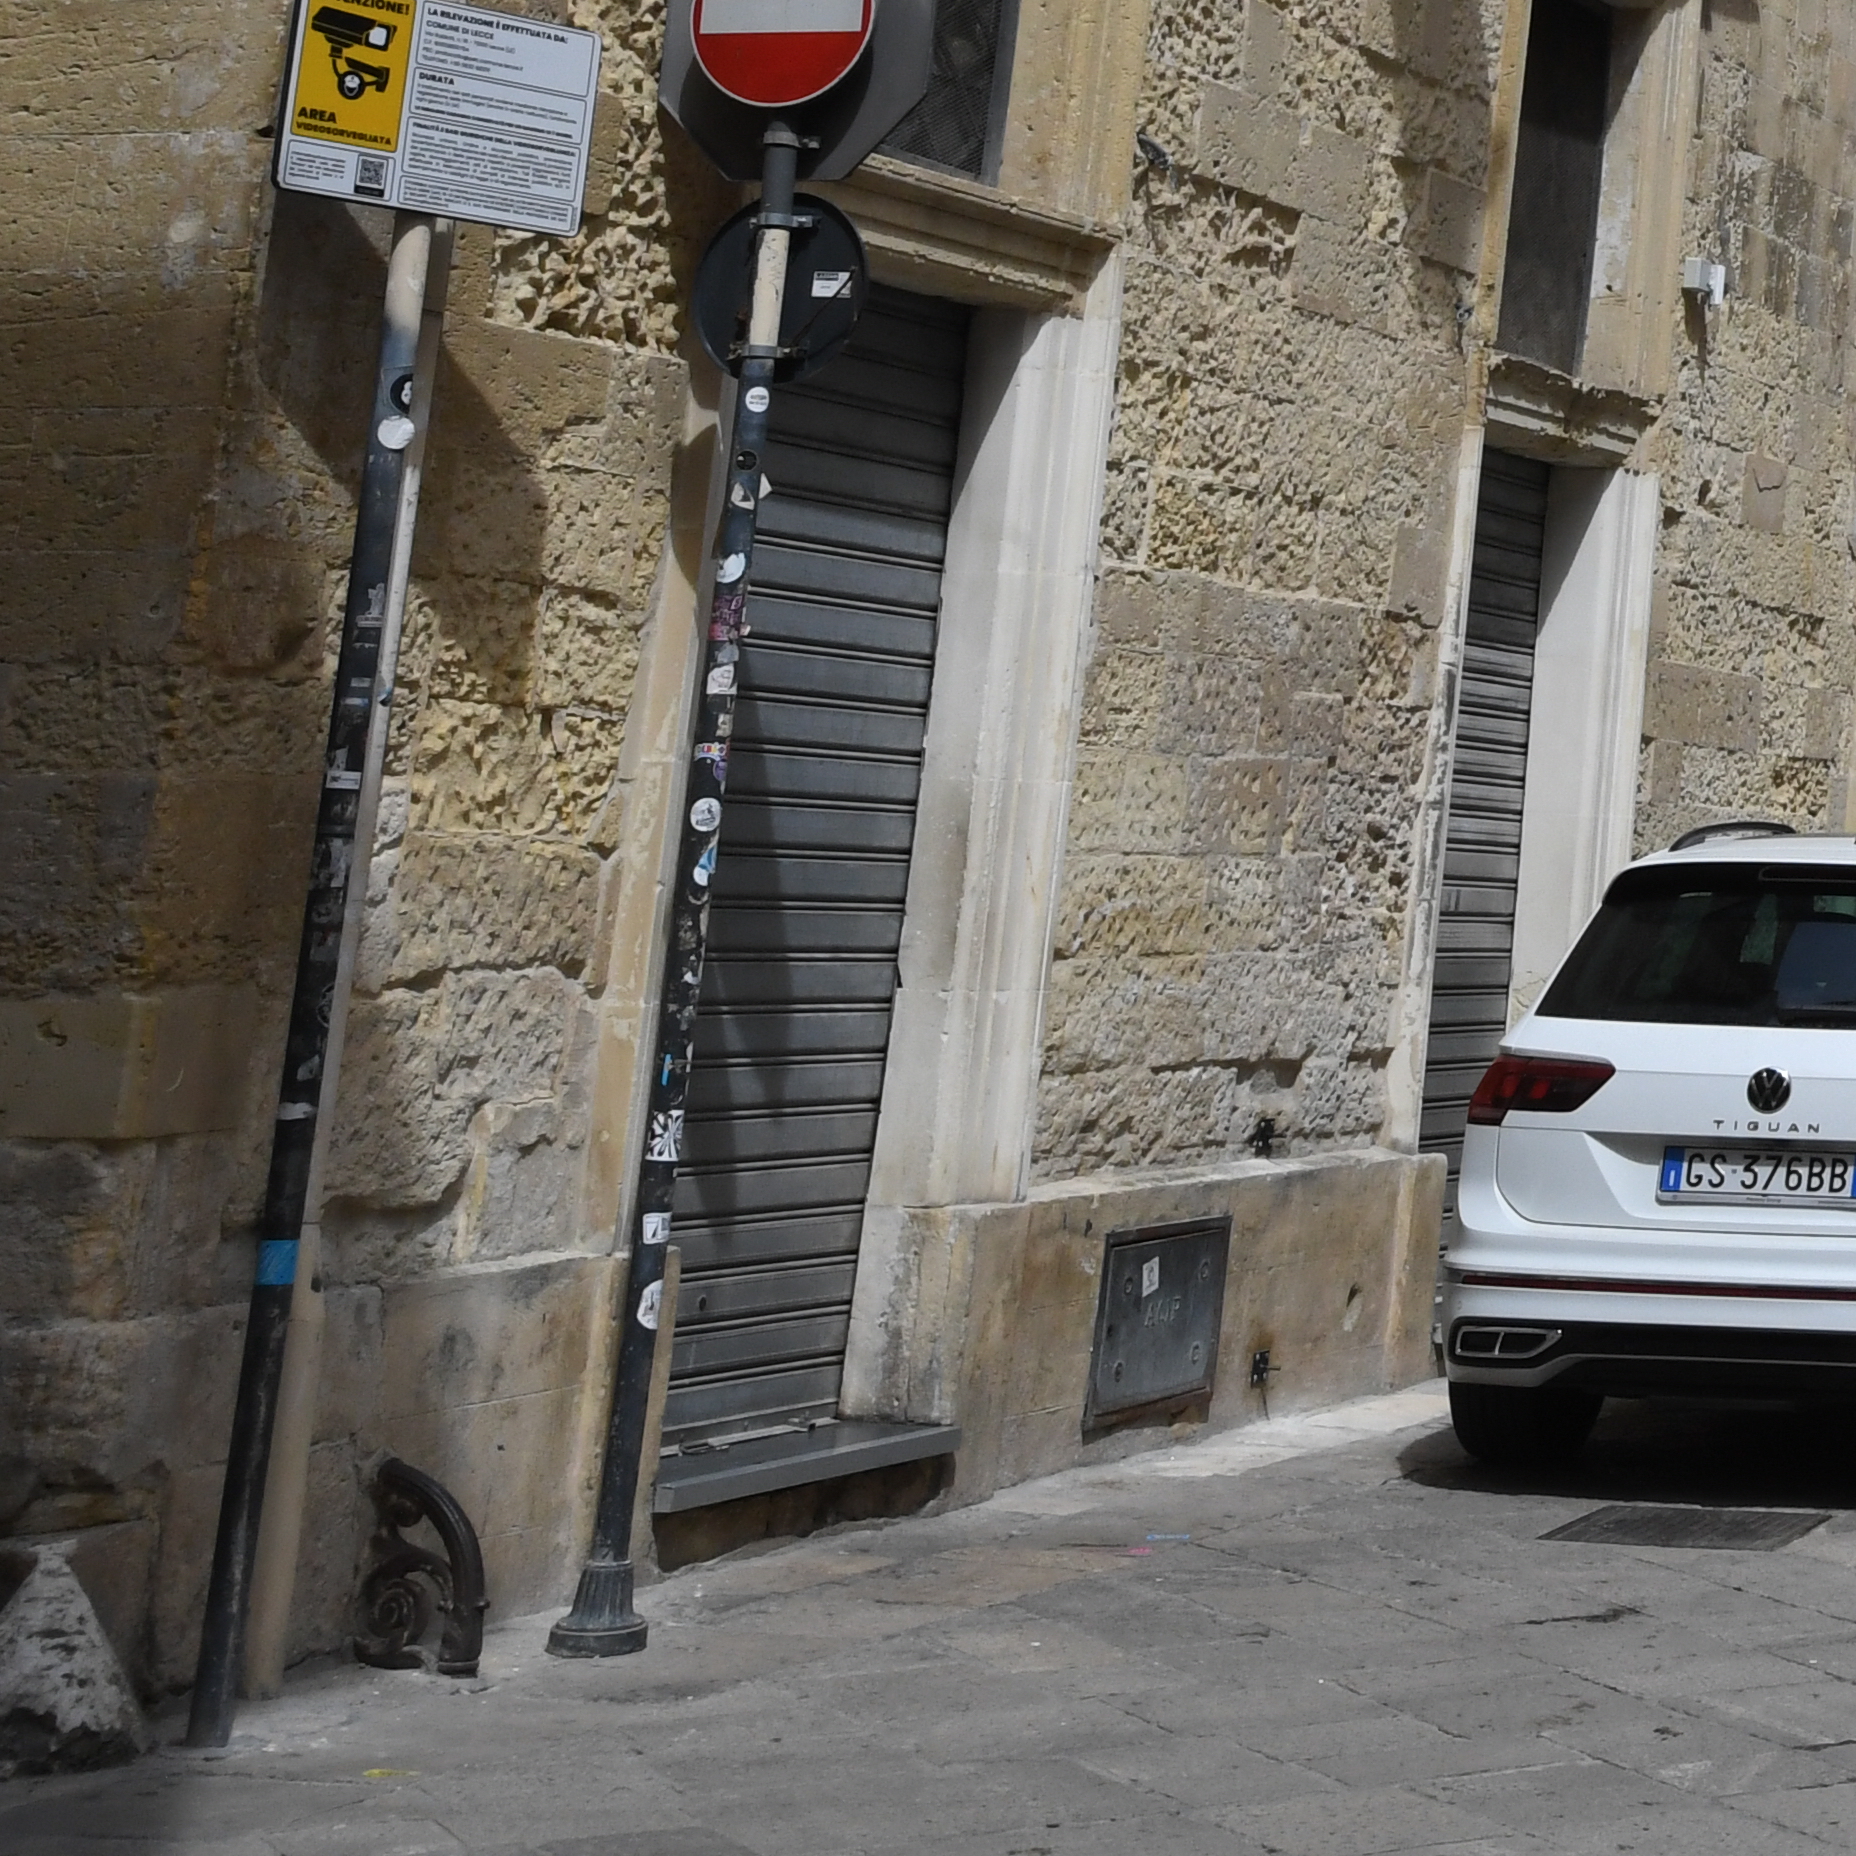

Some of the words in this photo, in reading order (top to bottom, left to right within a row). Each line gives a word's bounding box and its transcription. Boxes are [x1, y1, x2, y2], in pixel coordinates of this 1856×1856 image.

[426, 20, 460, 34] COMUNE
[461, 26, 470, 35] DI
[471, 27, 495, 40] LECCE
[428, 7, 439, 17] LA
[440, 10, 495, 27] RILEVAZIONE
[501, 23, 553, 41] EFFETTUATA
[418, 71, 455, 86] DURATA
[297, 106, 338, 124] AREA
[296, 121, 392, 146] VIDEOSORVEGLIATA
[1712, 1119, 1820, 1134] TIGUAN
